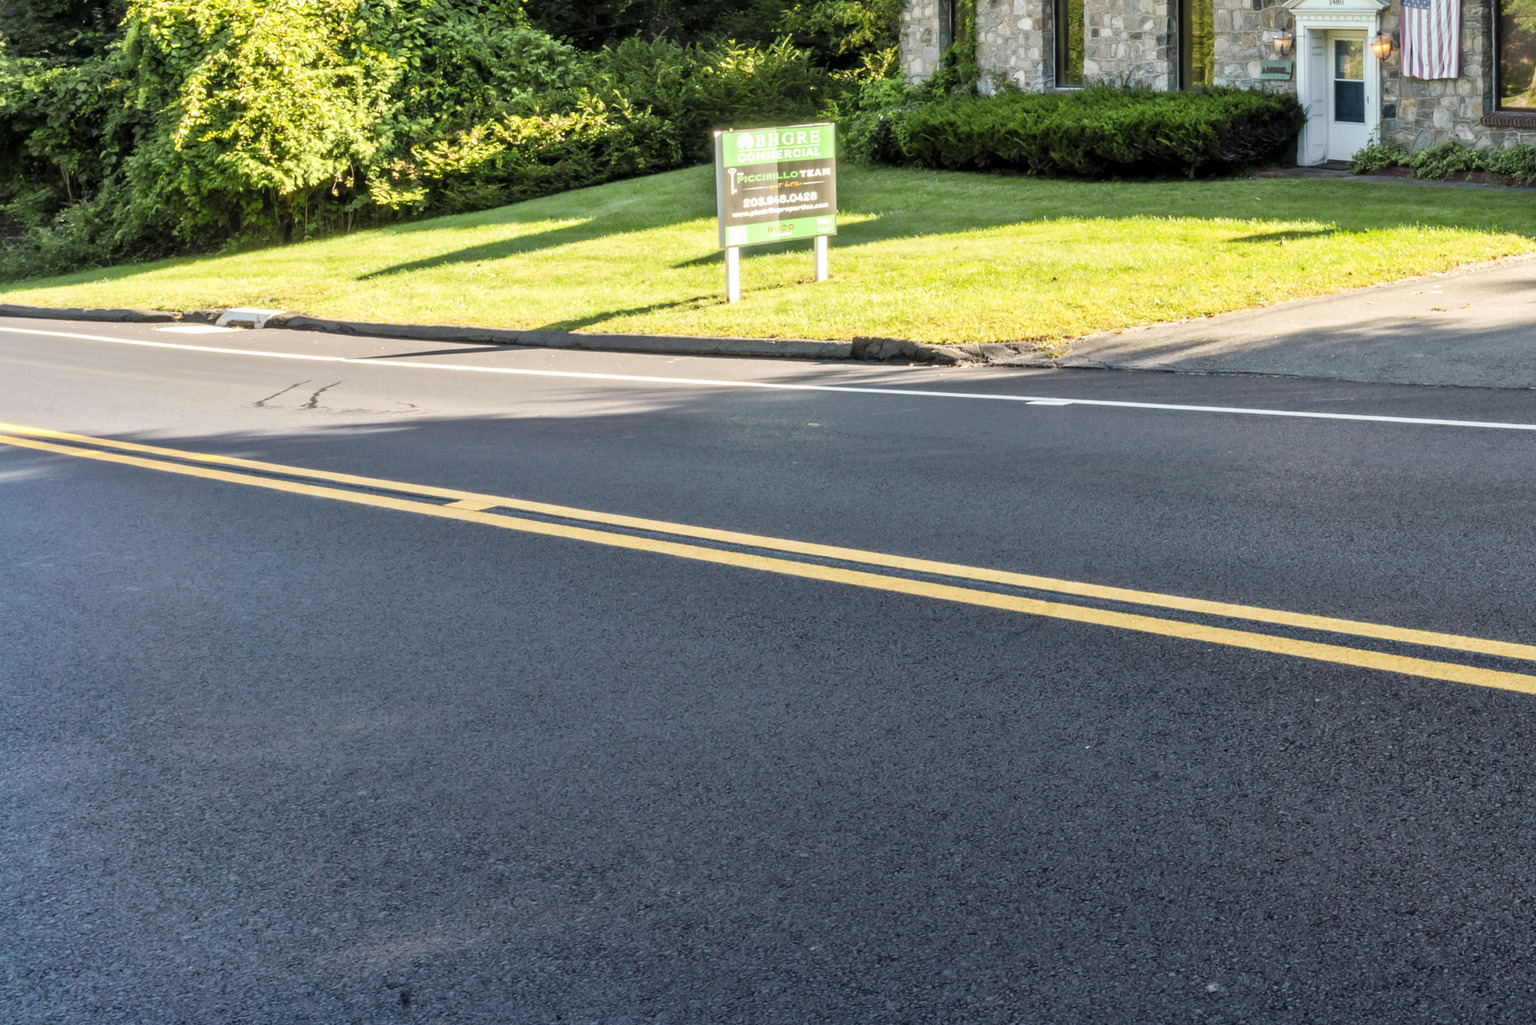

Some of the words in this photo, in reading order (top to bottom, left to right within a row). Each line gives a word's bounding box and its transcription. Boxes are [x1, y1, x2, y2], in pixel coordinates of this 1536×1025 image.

[755, 130, 820, 147] BHGRE
[737, 147, 821, 163] COMMERCIAL
[737, 170, 799, 184] PICCIRILLO
[799, 167, 831, 178] TEAM
